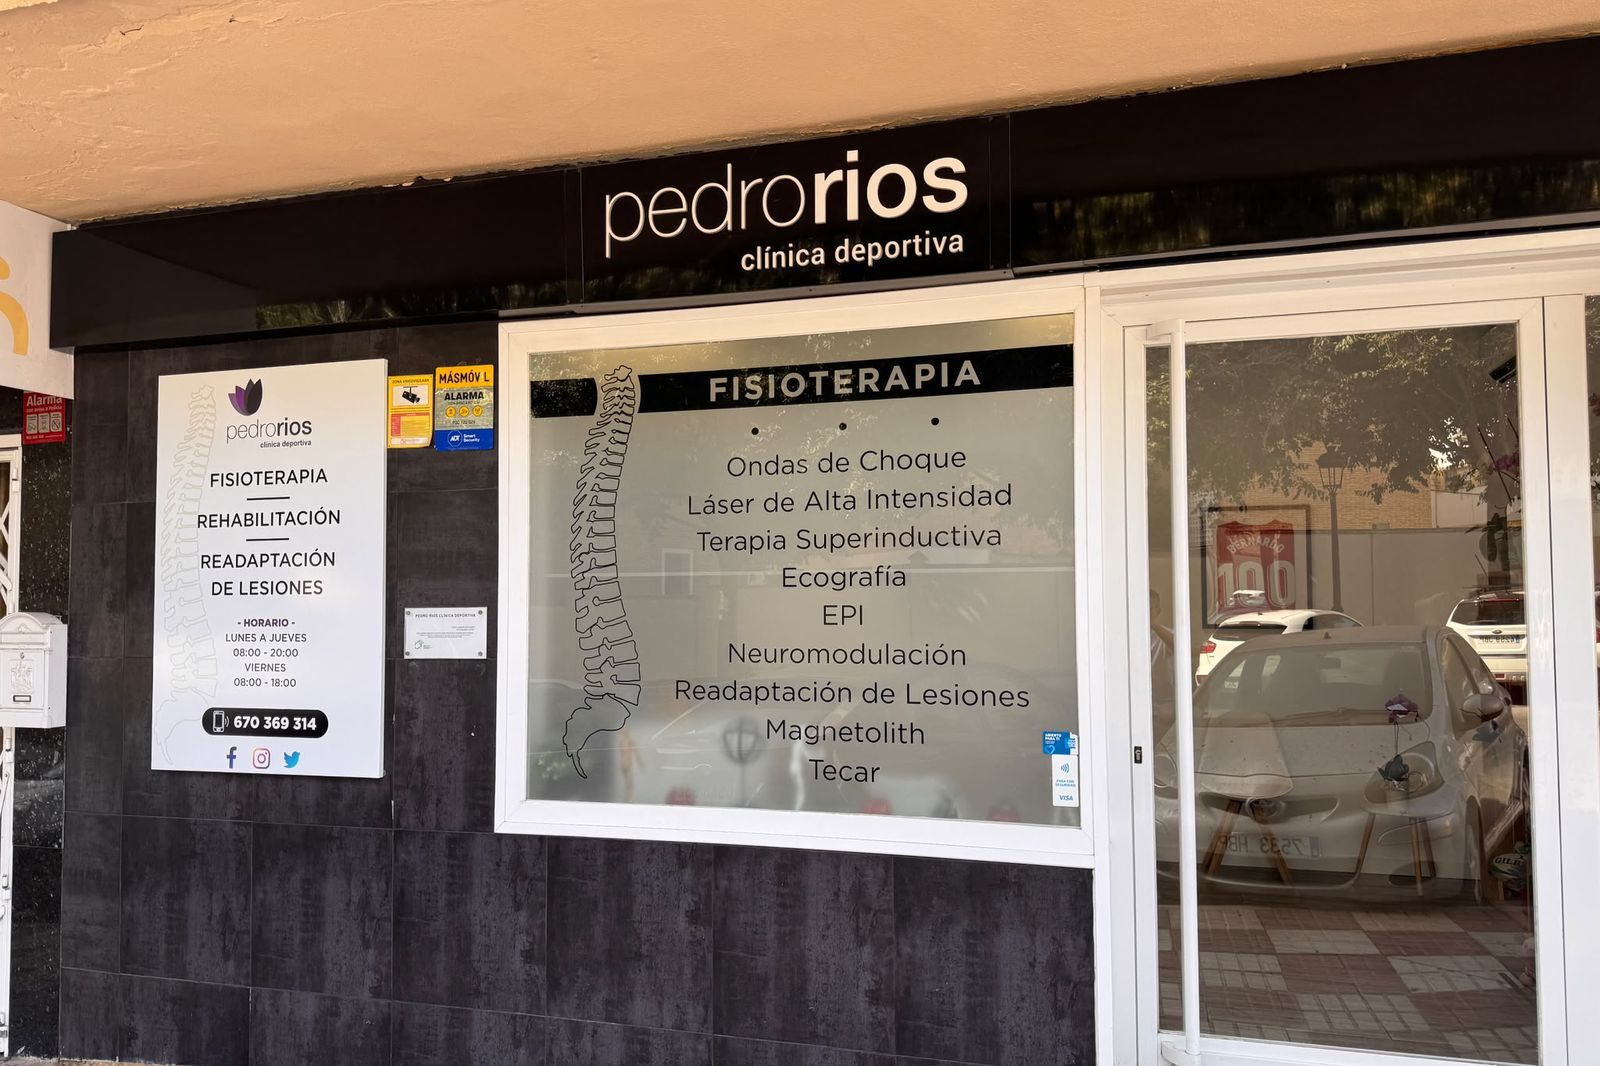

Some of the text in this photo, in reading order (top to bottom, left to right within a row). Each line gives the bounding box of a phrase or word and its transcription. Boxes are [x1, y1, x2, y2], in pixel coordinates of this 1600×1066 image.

[605, 149, 968, 259] pedrorios
[741, 230, 964, 271] clínica deportiva
[710, 360, 981, 402] FISIOTERAPIA
[27, 394, 63, 407] Alarma
[444, 391, 484, 401] ALARMA
[226, 417, 312, 444] pedrorios
[260, 439, 312, 449] clínica deportiva
[727, 450, 967, 477] Ondas de Choque
[210, 468, 328, 488] FISIOTERAPIA
[688, 484, 1012, 515] Láser de Alta Intensidad
[197, 507, 341, 529] REHABILITACIÓN
[697, 525, 1002, 555] Terapia Superinductiva
[1226, 535, 1285, 554] BERNARDO
[201, 549, 336, 569] READAPTACIÓN
[211, 580, 324, 596] DE LESIONES
[782, 565, 907, 591] Ecografía
[1217, 560, 1296, 609] 100
[243, 618, 289, 628] HORARIO
[823, 605, 864, 626] EPI
[225, 633, 307, 643] LUNES A JUEVES
[233, 648, 261, 657] 08:00
[270, 648, 299, 657] 20:00
[728, 643, 967, 666] Neuromodulación
[244, 663, 287, 672] VIERNES
[233, 677, 262, 687] 08:00
[271, 678, 297, 687] 18:00
[675, 680, 1030, 707] Readaptación de Lesiones
[233, 716, 317, 731] 670 369 314
[766, 718, 925, 745] Magnetolith
[809, 759, 881, 783] Tecar
